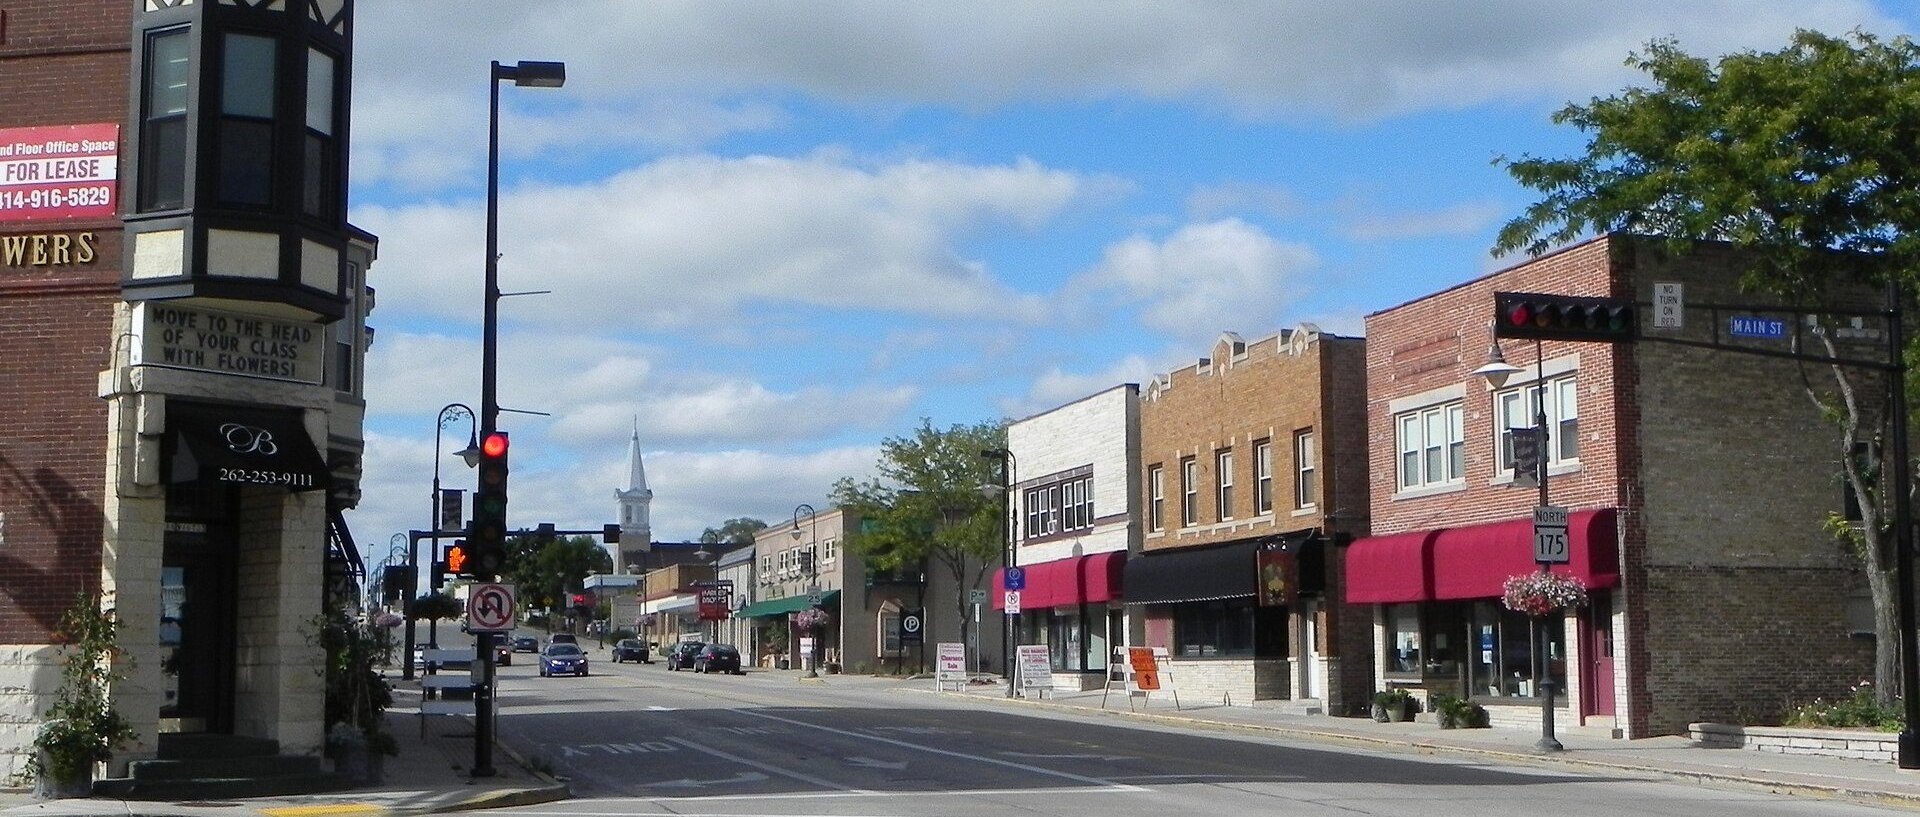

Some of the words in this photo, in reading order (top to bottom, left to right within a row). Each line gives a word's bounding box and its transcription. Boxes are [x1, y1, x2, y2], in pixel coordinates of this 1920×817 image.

[15, 142, 44, 156] Floor
[45, 140, 79, 154] Office
[81, 139, 115, 153] Space
[6, 162, 40, 182] FOR
[45, 159, 100, 180] LEASE
[2, 232, 94, 266] WERS
[1663, 285, 1673, 294] NO
[1660, 295, 1678, 305] TURN
[1663, 306, 1673, 316] ON
[152, 307, 197, 329] MOVE
[208, 314, 228, 332] TO
[235, 319, 263, 337] THE
[271, 322, 312, 343] HEAD
[1661, 317, 1675, 327] RED
[1733, 319, 1766, 335] MAIN
[1769, 321, 1783, 335] ST
[163, 328, 184, 345] OF
[197, 331, 239, 353] YOUR
[250, 340, 298, 360] CLASS
[164, 346, 205, 366] WITH
[218, 352, 296, 377] FLOWERS!
[220, 467, 312, 486] 262-253-9111
[1535, 510, 1566, 523] NORTH
[1540, 534, 1564, 555] 175
[808, 595, 821, 603] 25
[970, 591, 978, 601] P
[561, 742, 678, 757] ONLY
